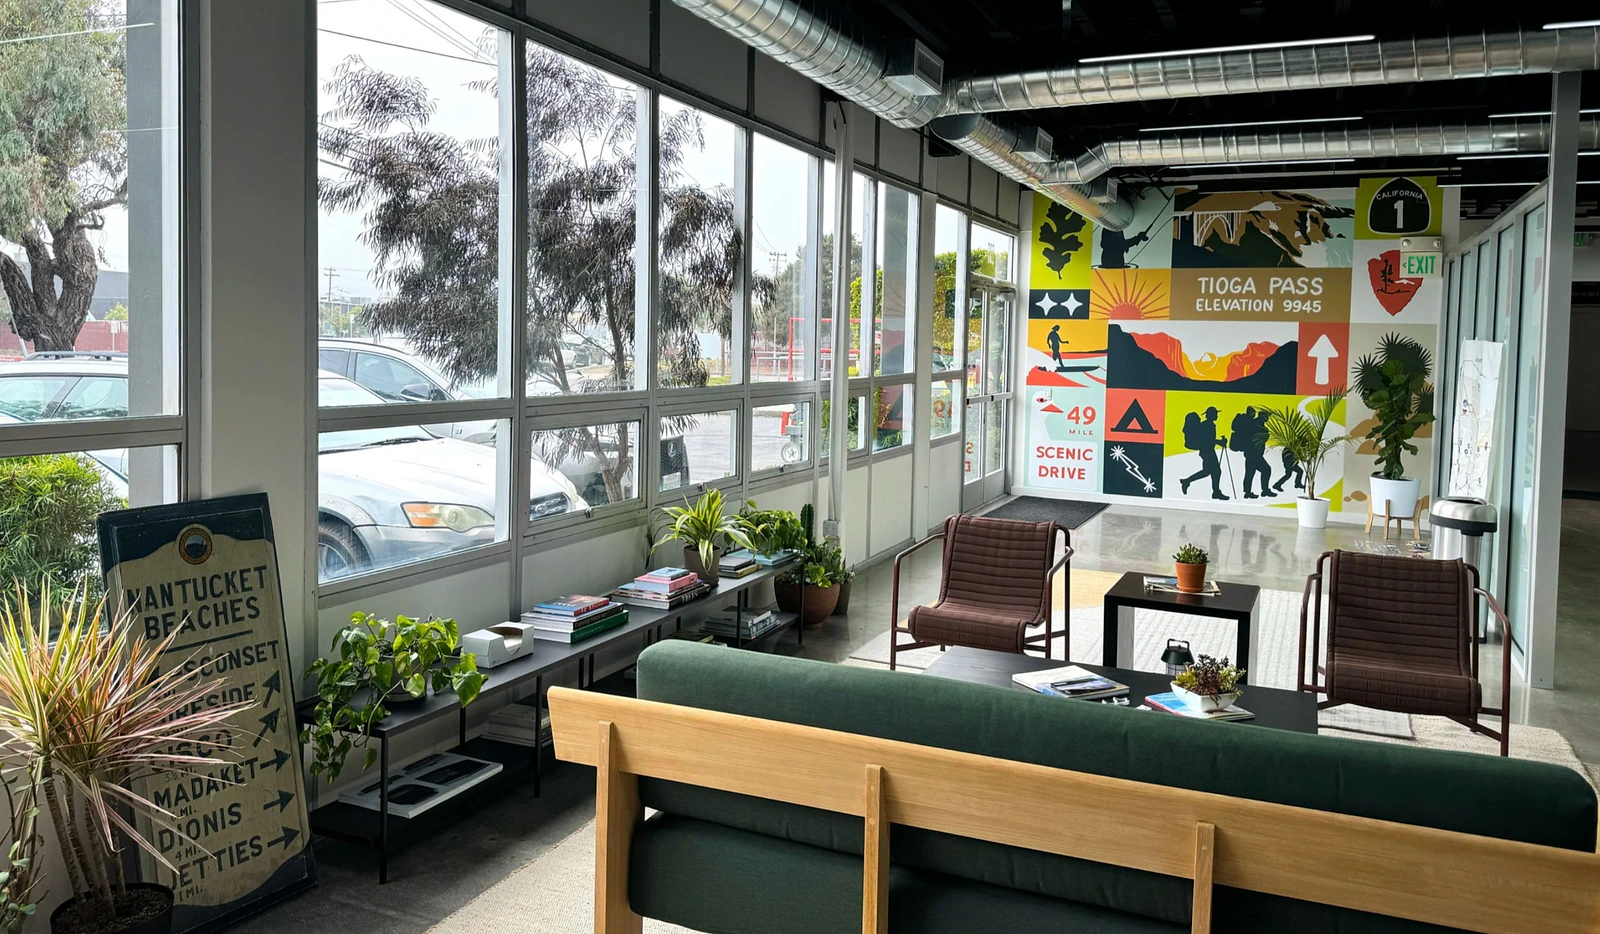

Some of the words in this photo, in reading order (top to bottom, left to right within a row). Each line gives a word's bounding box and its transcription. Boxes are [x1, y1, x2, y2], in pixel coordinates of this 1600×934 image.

[1376, 189, 1423, 201] CALIFORNIA
[1393, 200, 1404, 229] 1
[1407, 255, 1436, 275] EXIT
[1197, 276, 1257, 295] TIOGA
[1269, 276, 1323, 295] PASS
[1195, 298, 1273, 312] ELEVATION
[1283, 299, 1322, 313] 9945
[1067, 406, 1096, 425] 49
[1036, 446, 1093, 461] SCENIC
[1038, 465, 1086, 480] DRIVE
[127, 565, 268, 615] NANTUCKET
[144, 596, 260, 640] BEACHES
[184, 640, 279, 682] SCONSET
[154, 757, 259, 813] MADAKET
[180, 805, 197, 817] MI.
[158, 802, 242, 853] DIONIS
[175, 850, 182, 861] 4
[185, 844, 201, 858] MI.
[166, 835, 263, 891] JETTIES
[178, 891, 184, 901] 1
[186, 885, 203, 898] MI.
